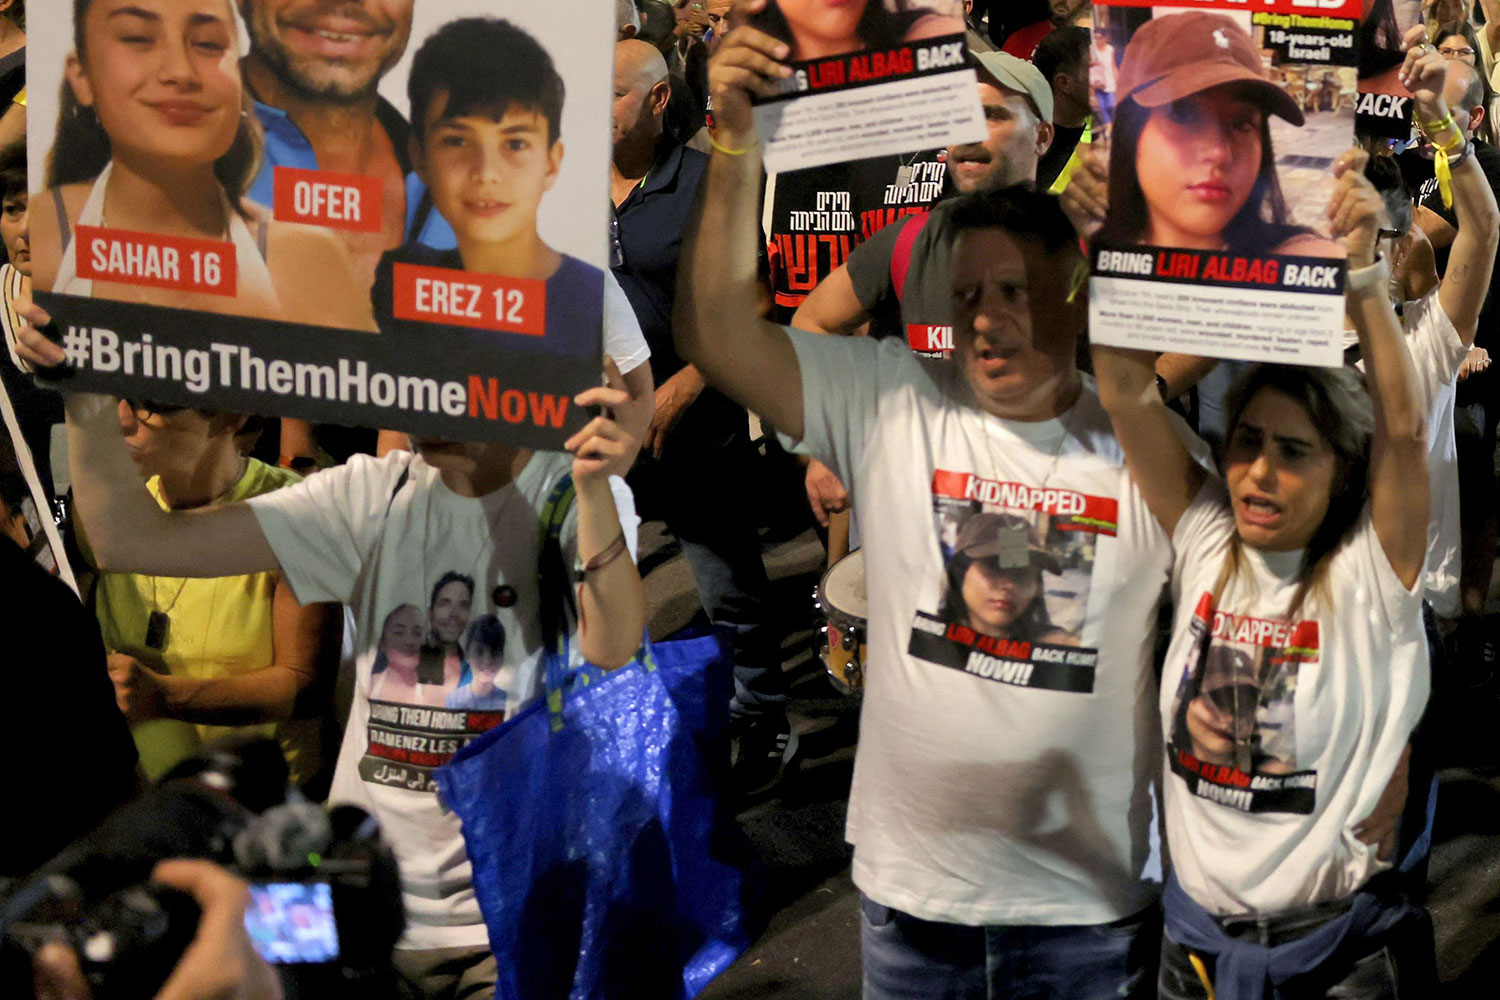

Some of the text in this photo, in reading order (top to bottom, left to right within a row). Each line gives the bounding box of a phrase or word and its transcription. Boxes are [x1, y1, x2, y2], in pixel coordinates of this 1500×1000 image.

[1269, 29, 1353, 50] 18-years-old
[1288, 44, 1330, 60] Israeli
[809, 60, 846, 88] LIRI
[849, 47, 914, 83] ALBAG
[917, 41, 965, 71] BACK
[1354, 92, 1409, 119] ACK
[294, 181, 361, 222] OFER
[790, 211, 830, 231] הביתה
[91, 239, 221, 286] SAHAR 16
[1097, 250, 1340, 289] BRING LIRI ALBAG BACK
[415, 278, 524, 324] EREZ 12
[62, 326, 570, 429] #BringThemHomeNow
[965, 475, 1087, 514] KIDNAPPED
[976, 636, 1031, 660] ALBAG
[1031, 647, 1065, 662] BACK
[965, 651, 1034, 686] NOW!!
[400, 707, 431, 727] THEM
[430, 709, 467, 730] HOME
[370, 729, 428, 751] RAMENEZ
[429, 739, 458, 754] LES
